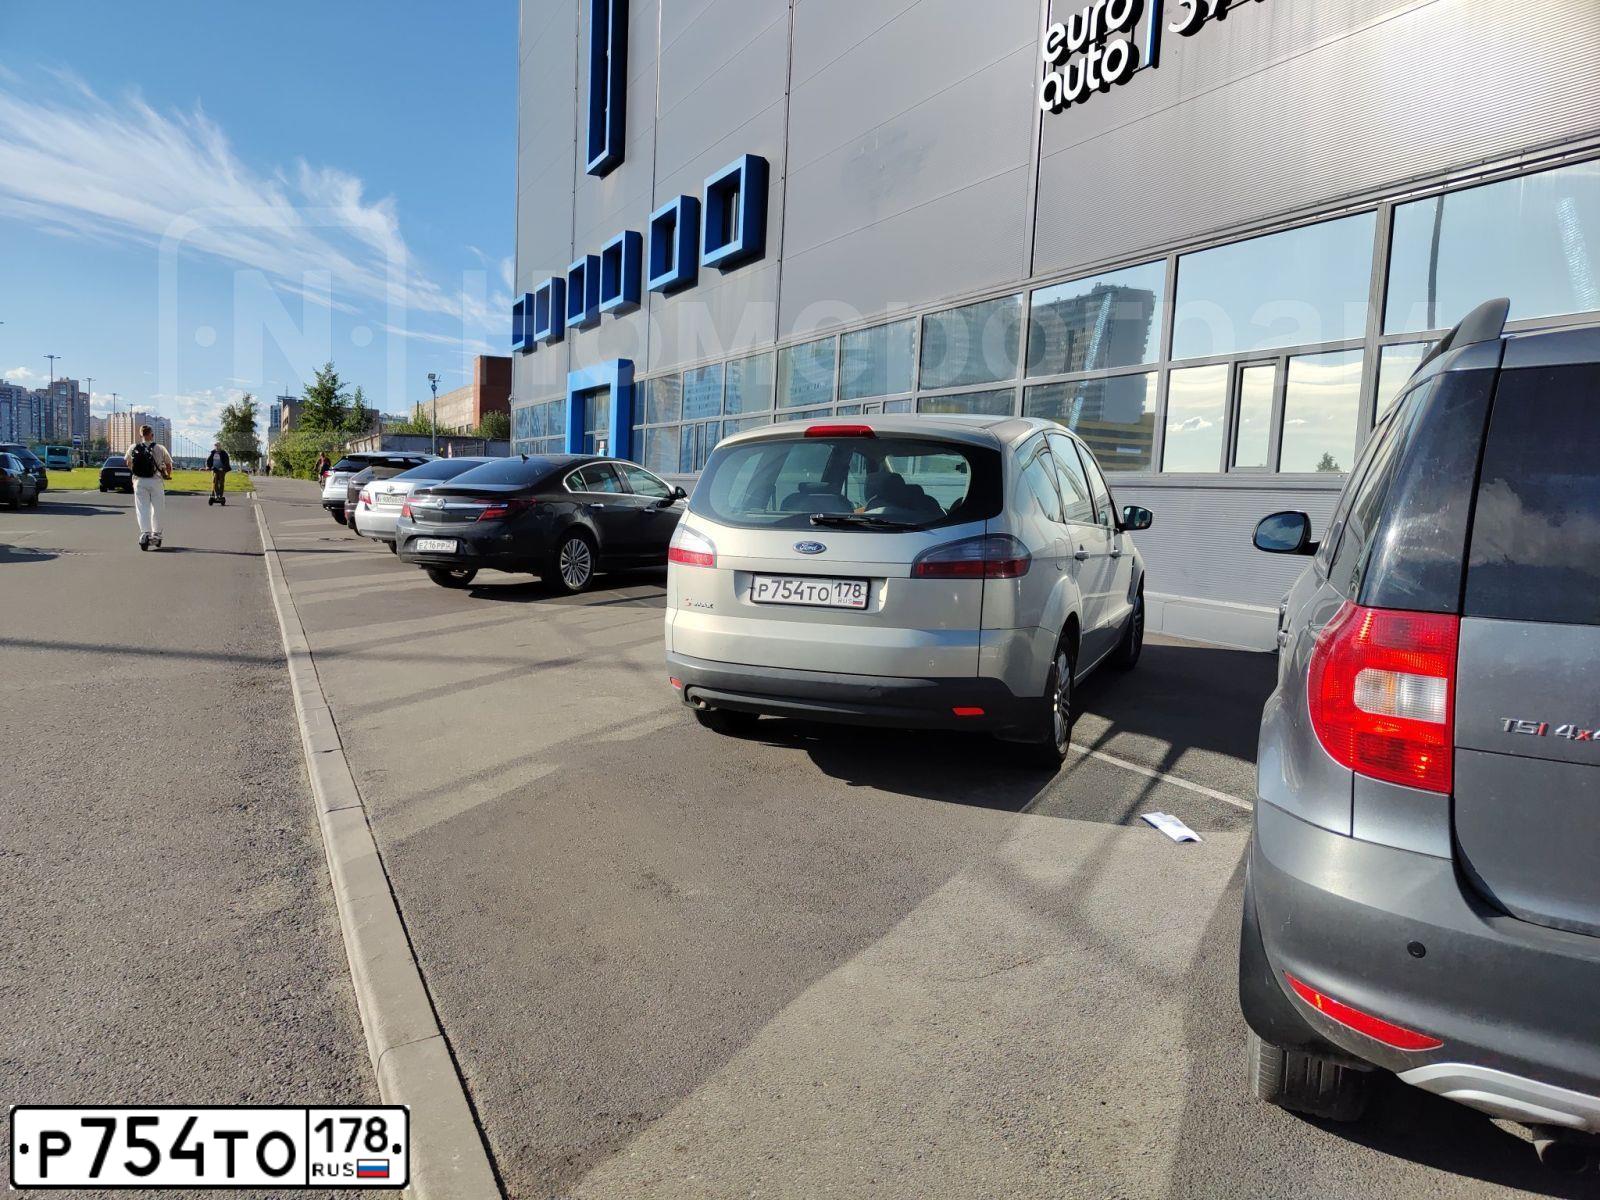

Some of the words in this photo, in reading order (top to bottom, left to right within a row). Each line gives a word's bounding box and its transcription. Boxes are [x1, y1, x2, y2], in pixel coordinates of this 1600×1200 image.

[1041, 0, 1134, 63] euro
[1038, 38, 1130, 111] auto
[799, 543, 817, 552] Ford
[834, 582, 862, 598] 178
[1500, 717, 1549, 737] TSI
